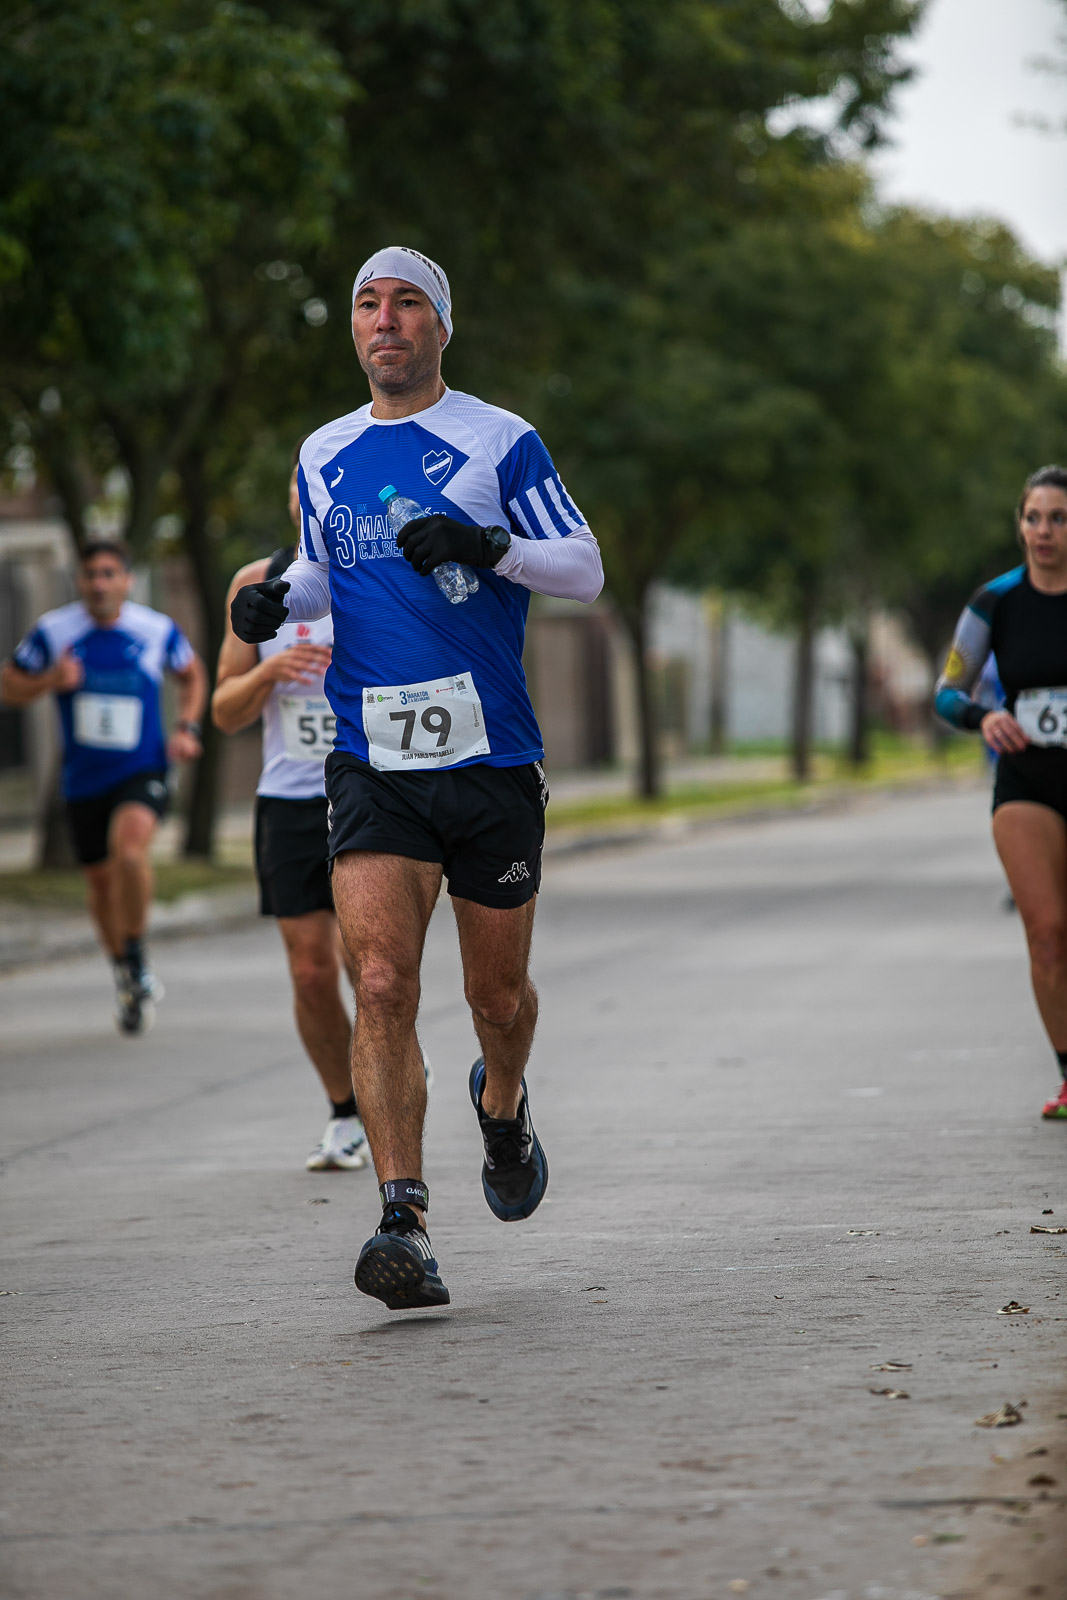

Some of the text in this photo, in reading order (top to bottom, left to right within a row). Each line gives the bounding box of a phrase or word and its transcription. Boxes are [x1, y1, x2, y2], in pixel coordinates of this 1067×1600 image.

[330, 505, 356, 569] 3
[399, 691, 408, 705] 3
[298, 716, 336, 745] 55
[389, 706, 452, 750] 79
